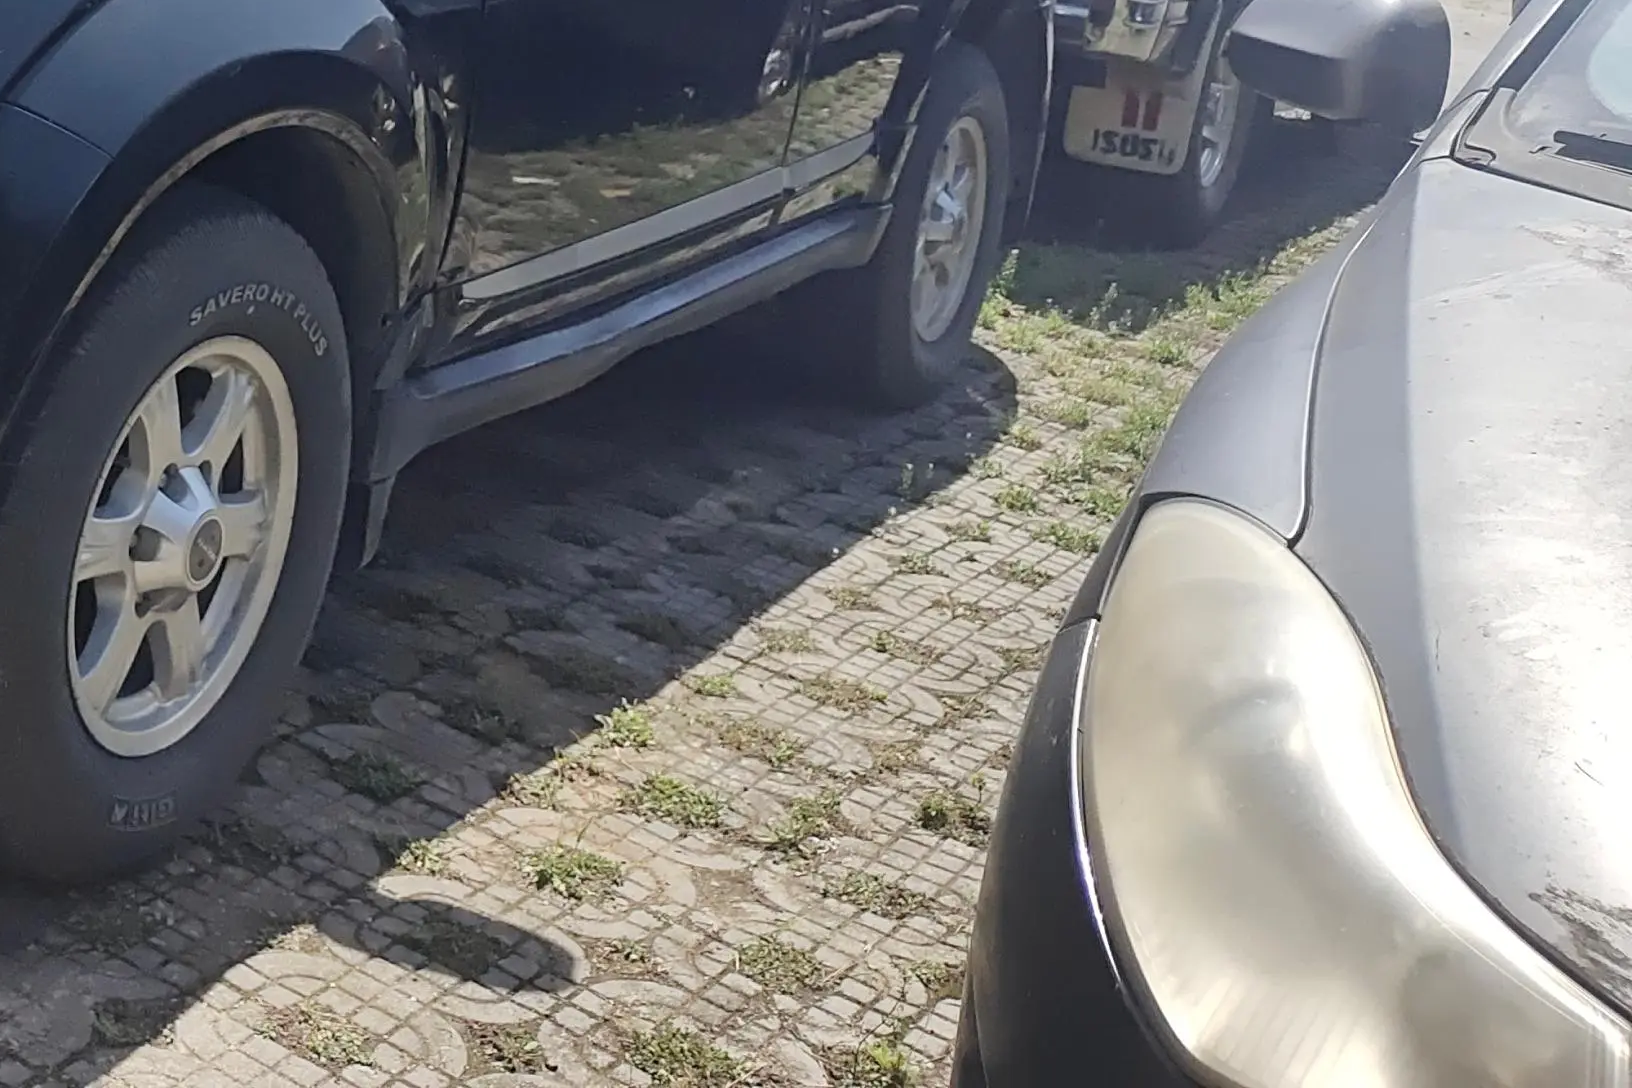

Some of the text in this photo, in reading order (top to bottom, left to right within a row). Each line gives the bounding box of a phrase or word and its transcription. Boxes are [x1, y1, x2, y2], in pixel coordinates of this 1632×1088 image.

[189, 283, 329, 356] SAVERO HT PLUS
